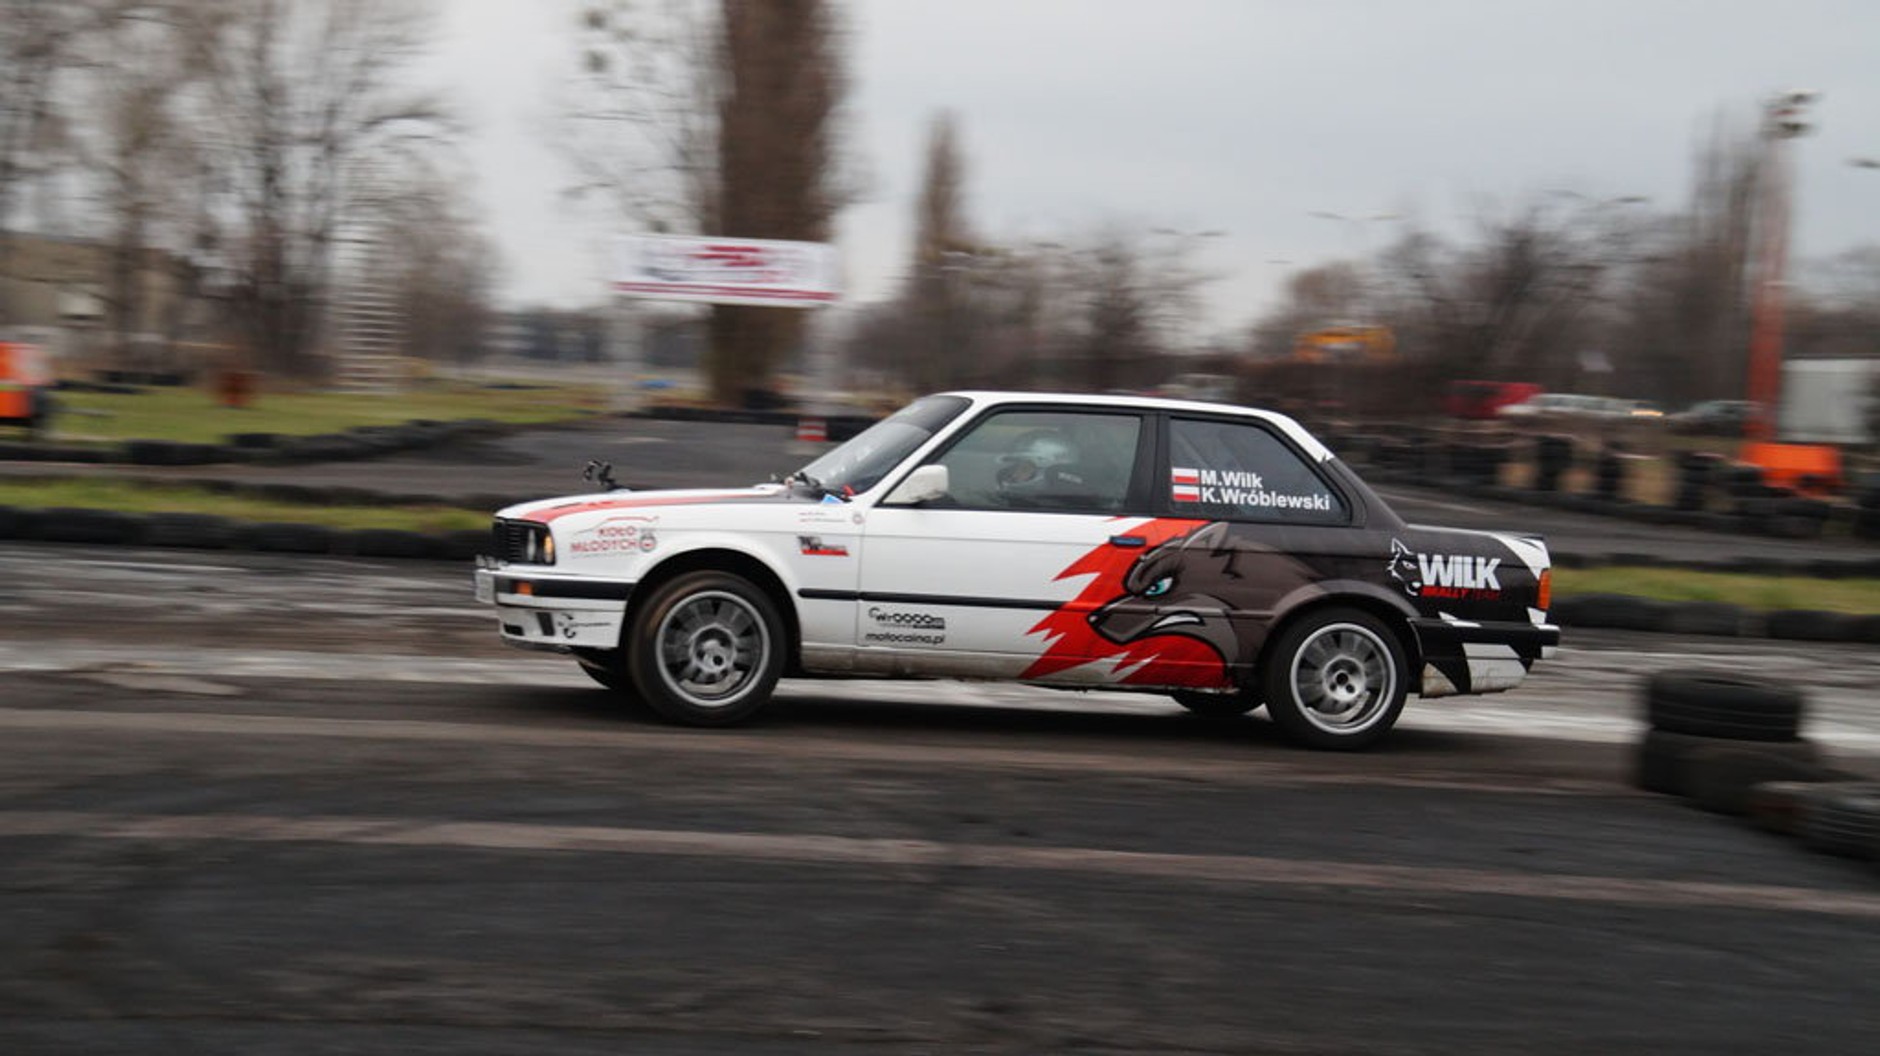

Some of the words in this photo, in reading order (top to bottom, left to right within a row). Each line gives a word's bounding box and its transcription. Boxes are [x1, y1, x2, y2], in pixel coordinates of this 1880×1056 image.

[1201, 470, 1262, 488] M.Wilk
[1202, 487, 1330, 510] K.Wróblewski
[1417, 553, 1501, 590] WILK
